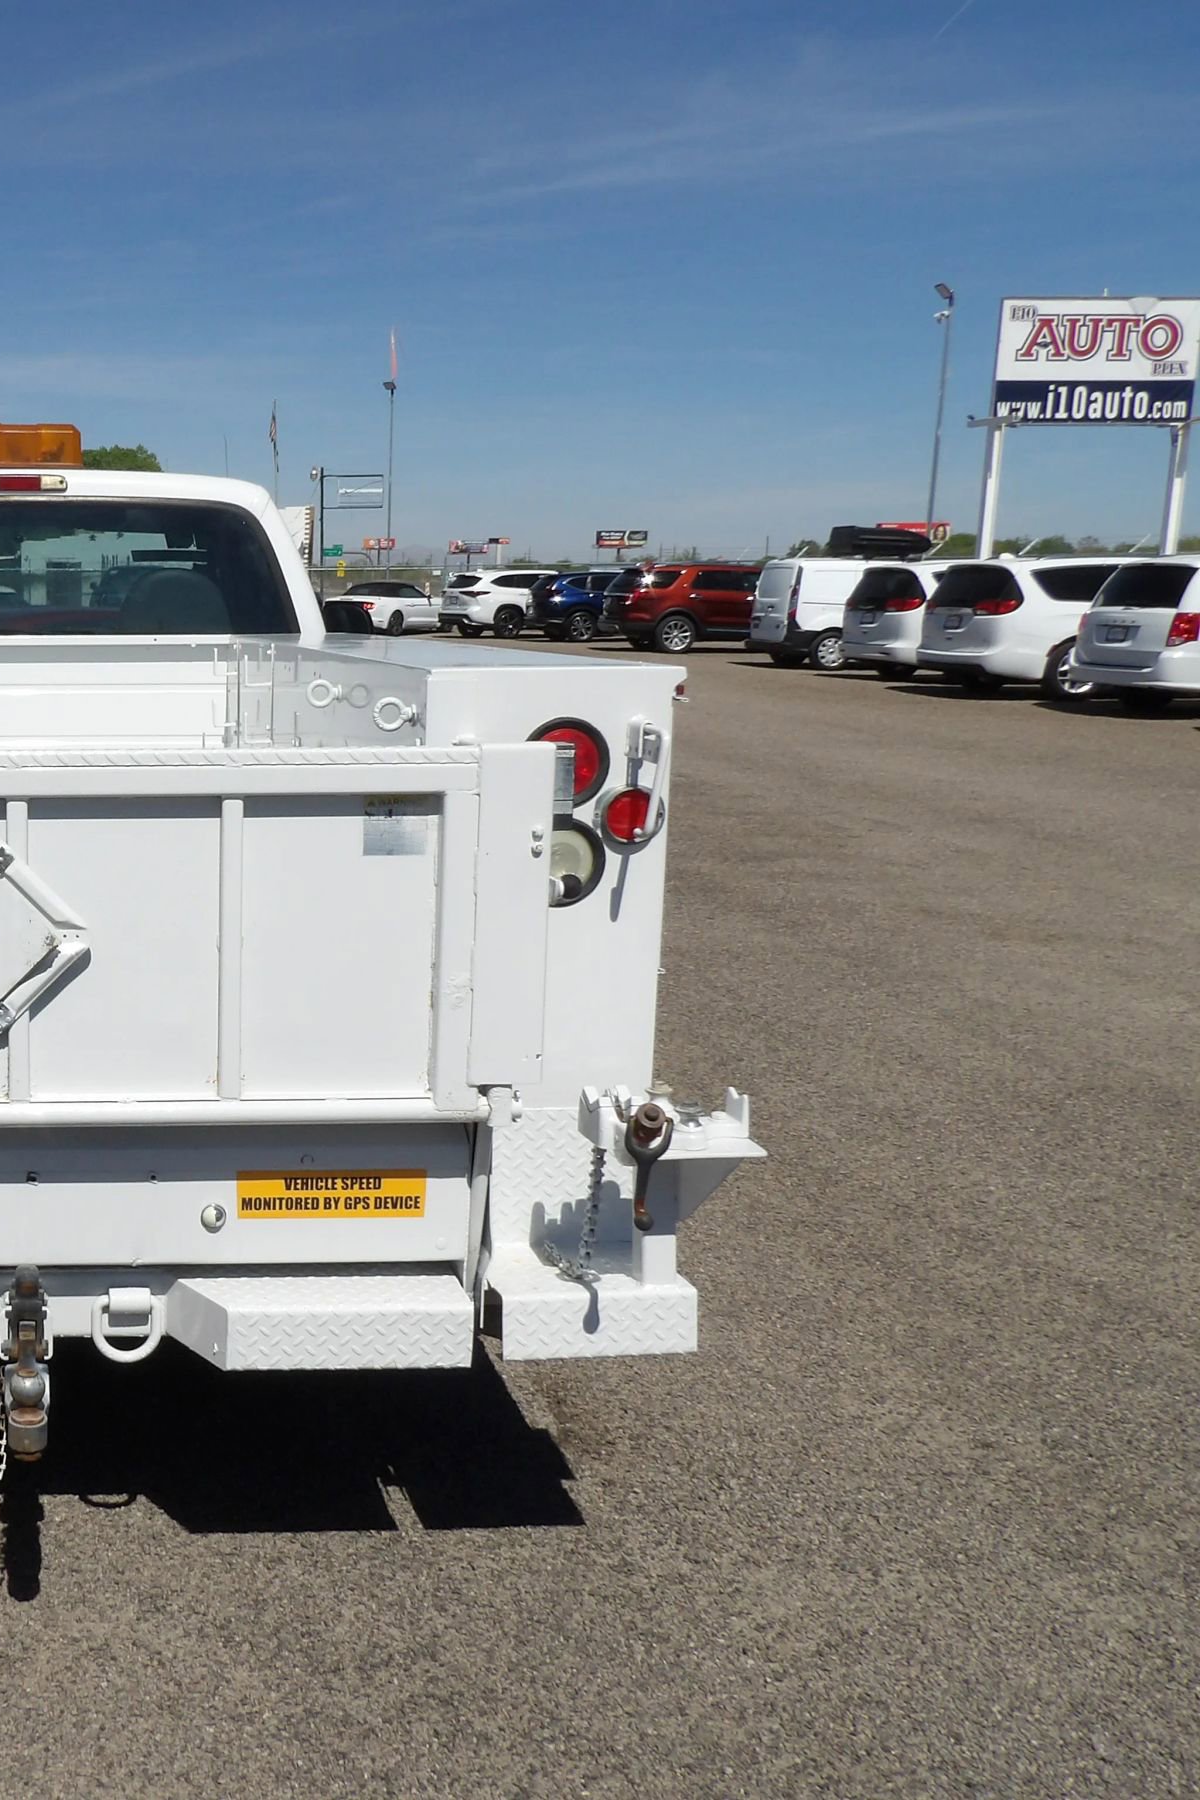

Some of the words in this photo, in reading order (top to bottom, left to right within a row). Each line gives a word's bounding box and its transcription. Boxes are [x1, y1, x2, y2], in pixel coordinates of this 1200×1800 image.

[1015, 314, 1184, 361] AUTO
[996, 384, 1187, 420] www.i10auto.com
[283, 1176, 339, 1191] VEHICLE
[341, 1176, 382, 1190] SPEED
[241, 1196, 320, 1211] MONITORED
[323, 1196, 341, 1210] BY
[344, 1196, 371, 1210] GPS
[373, 1195, 421, 1210] DEVICE
